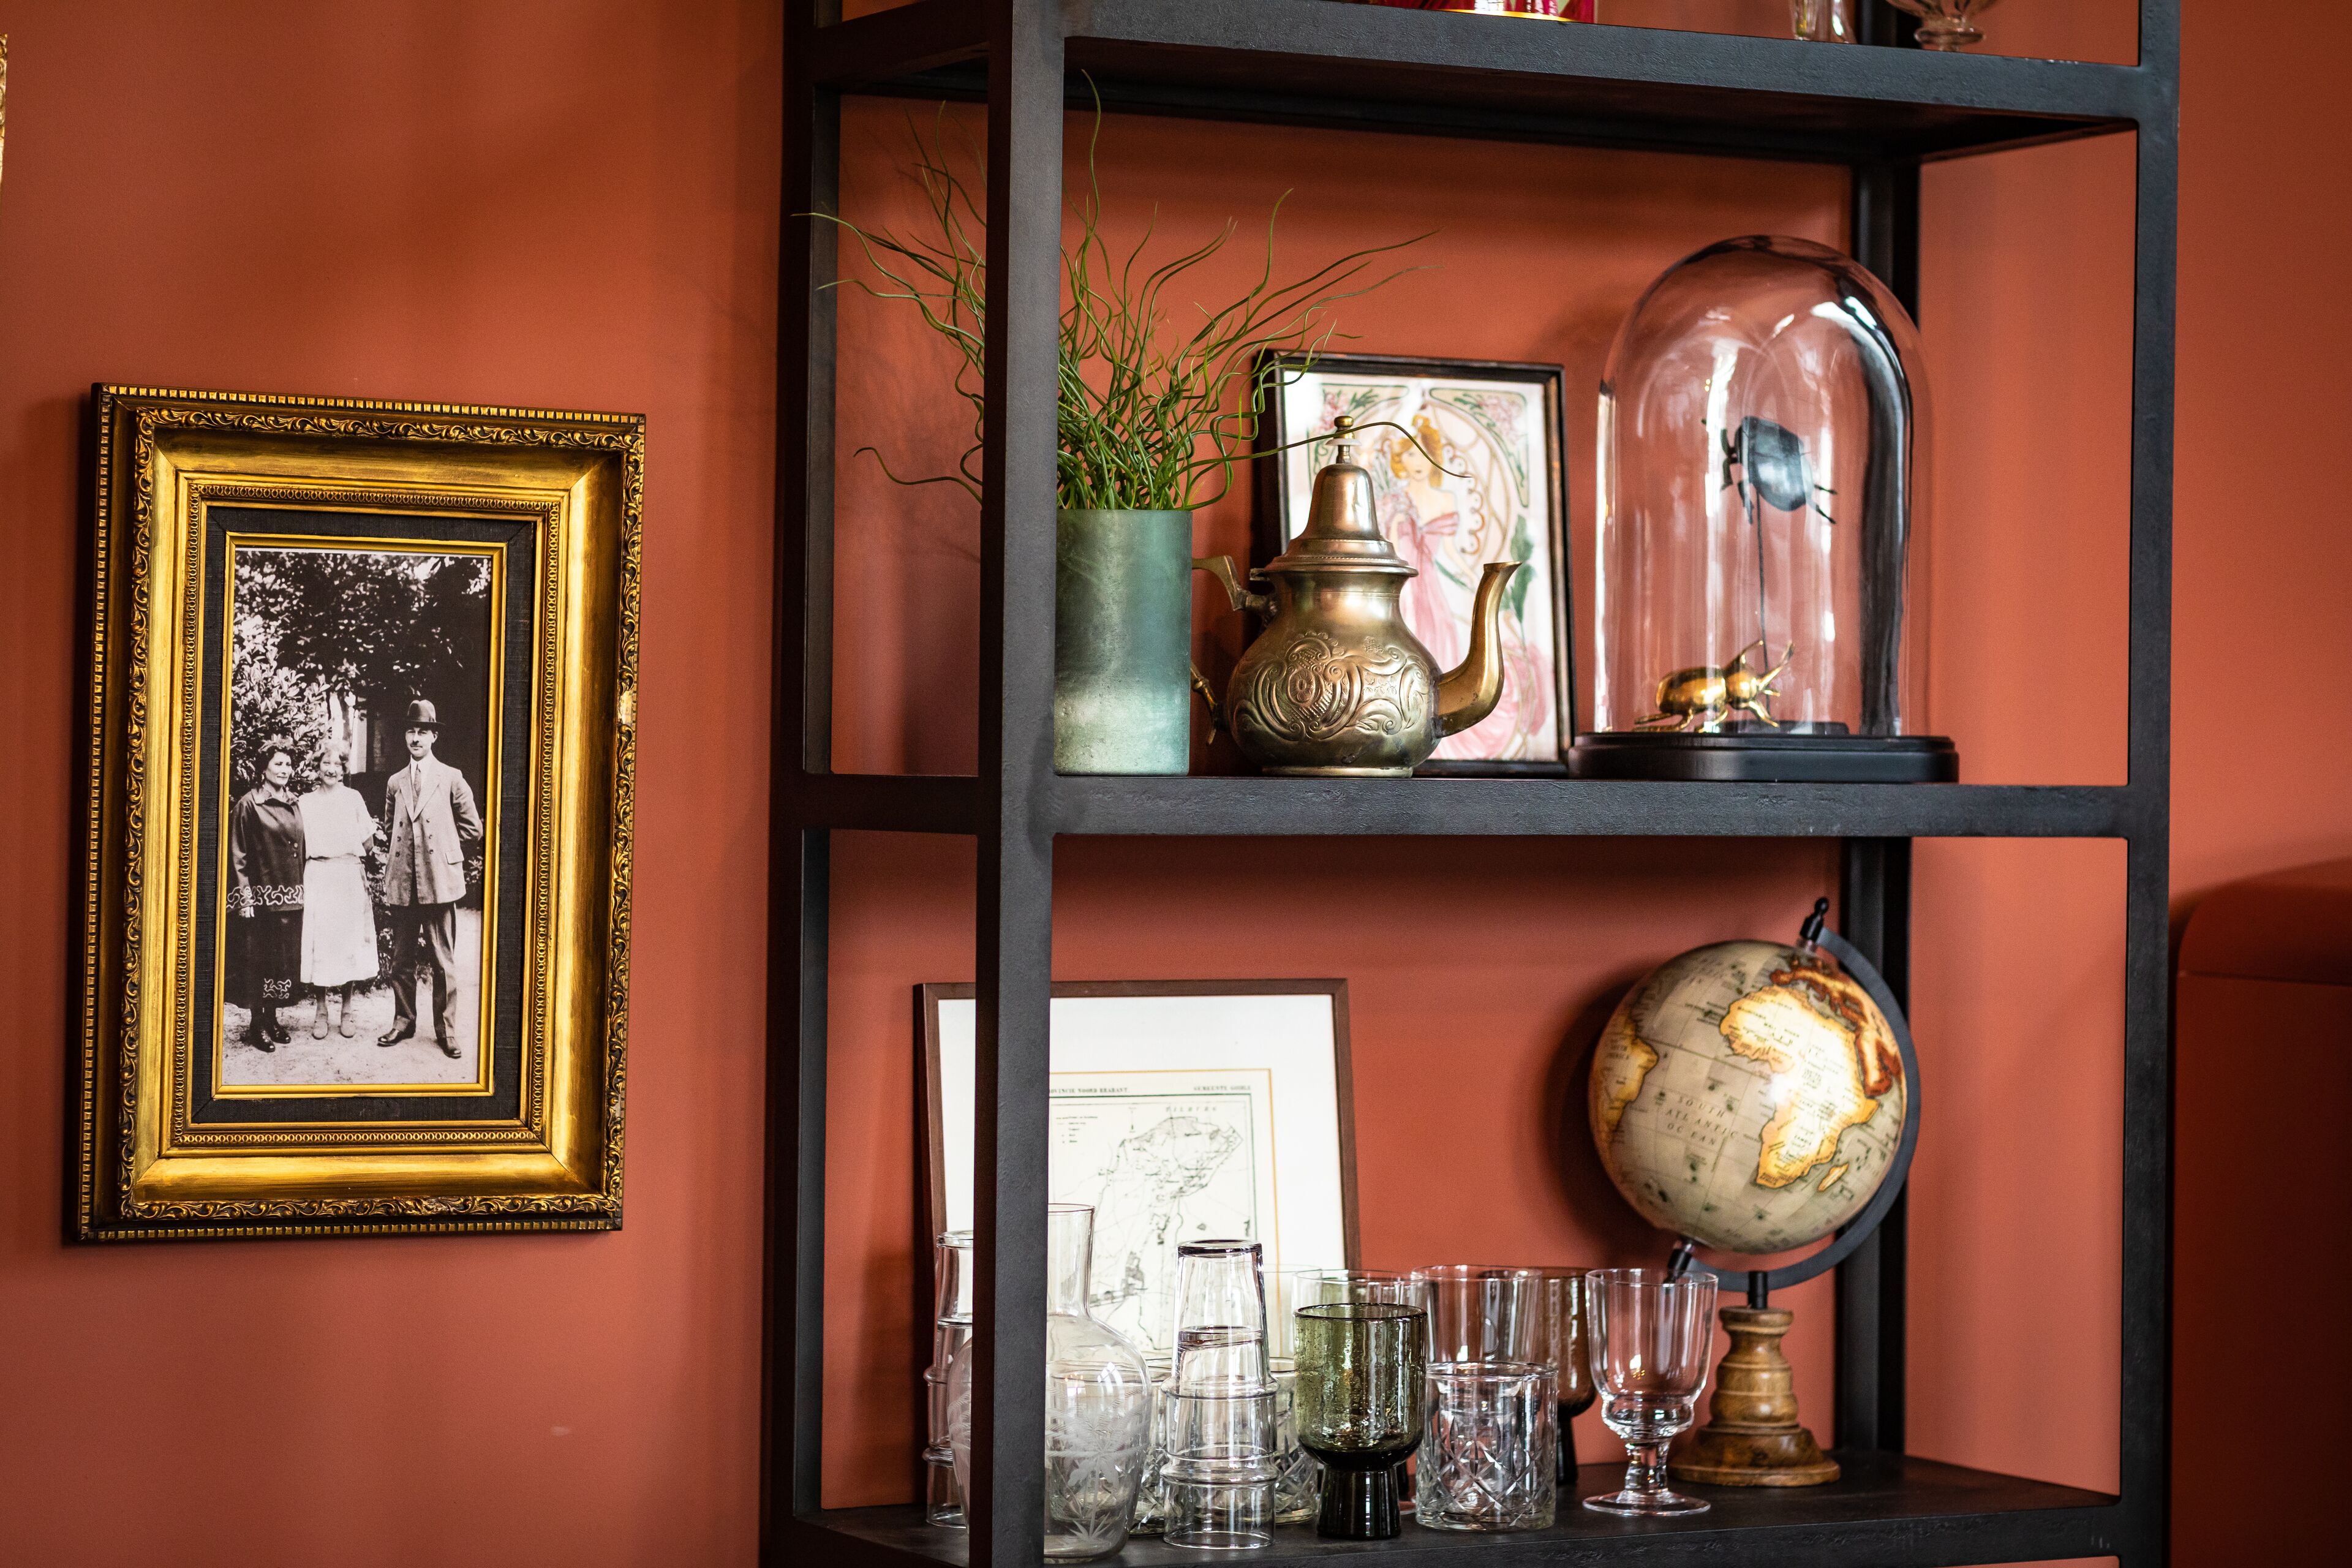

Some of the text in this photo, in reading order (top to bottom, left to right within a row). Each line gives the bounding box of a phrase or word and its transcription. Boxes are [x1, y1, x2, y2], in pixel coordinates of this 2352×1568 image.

[1679, 1096, 1725, 1118] SOUTH
[1665, 1109, 1738, 1138] ATLANTIC
[1667, 1123, 1715, 1145] OCEAN
